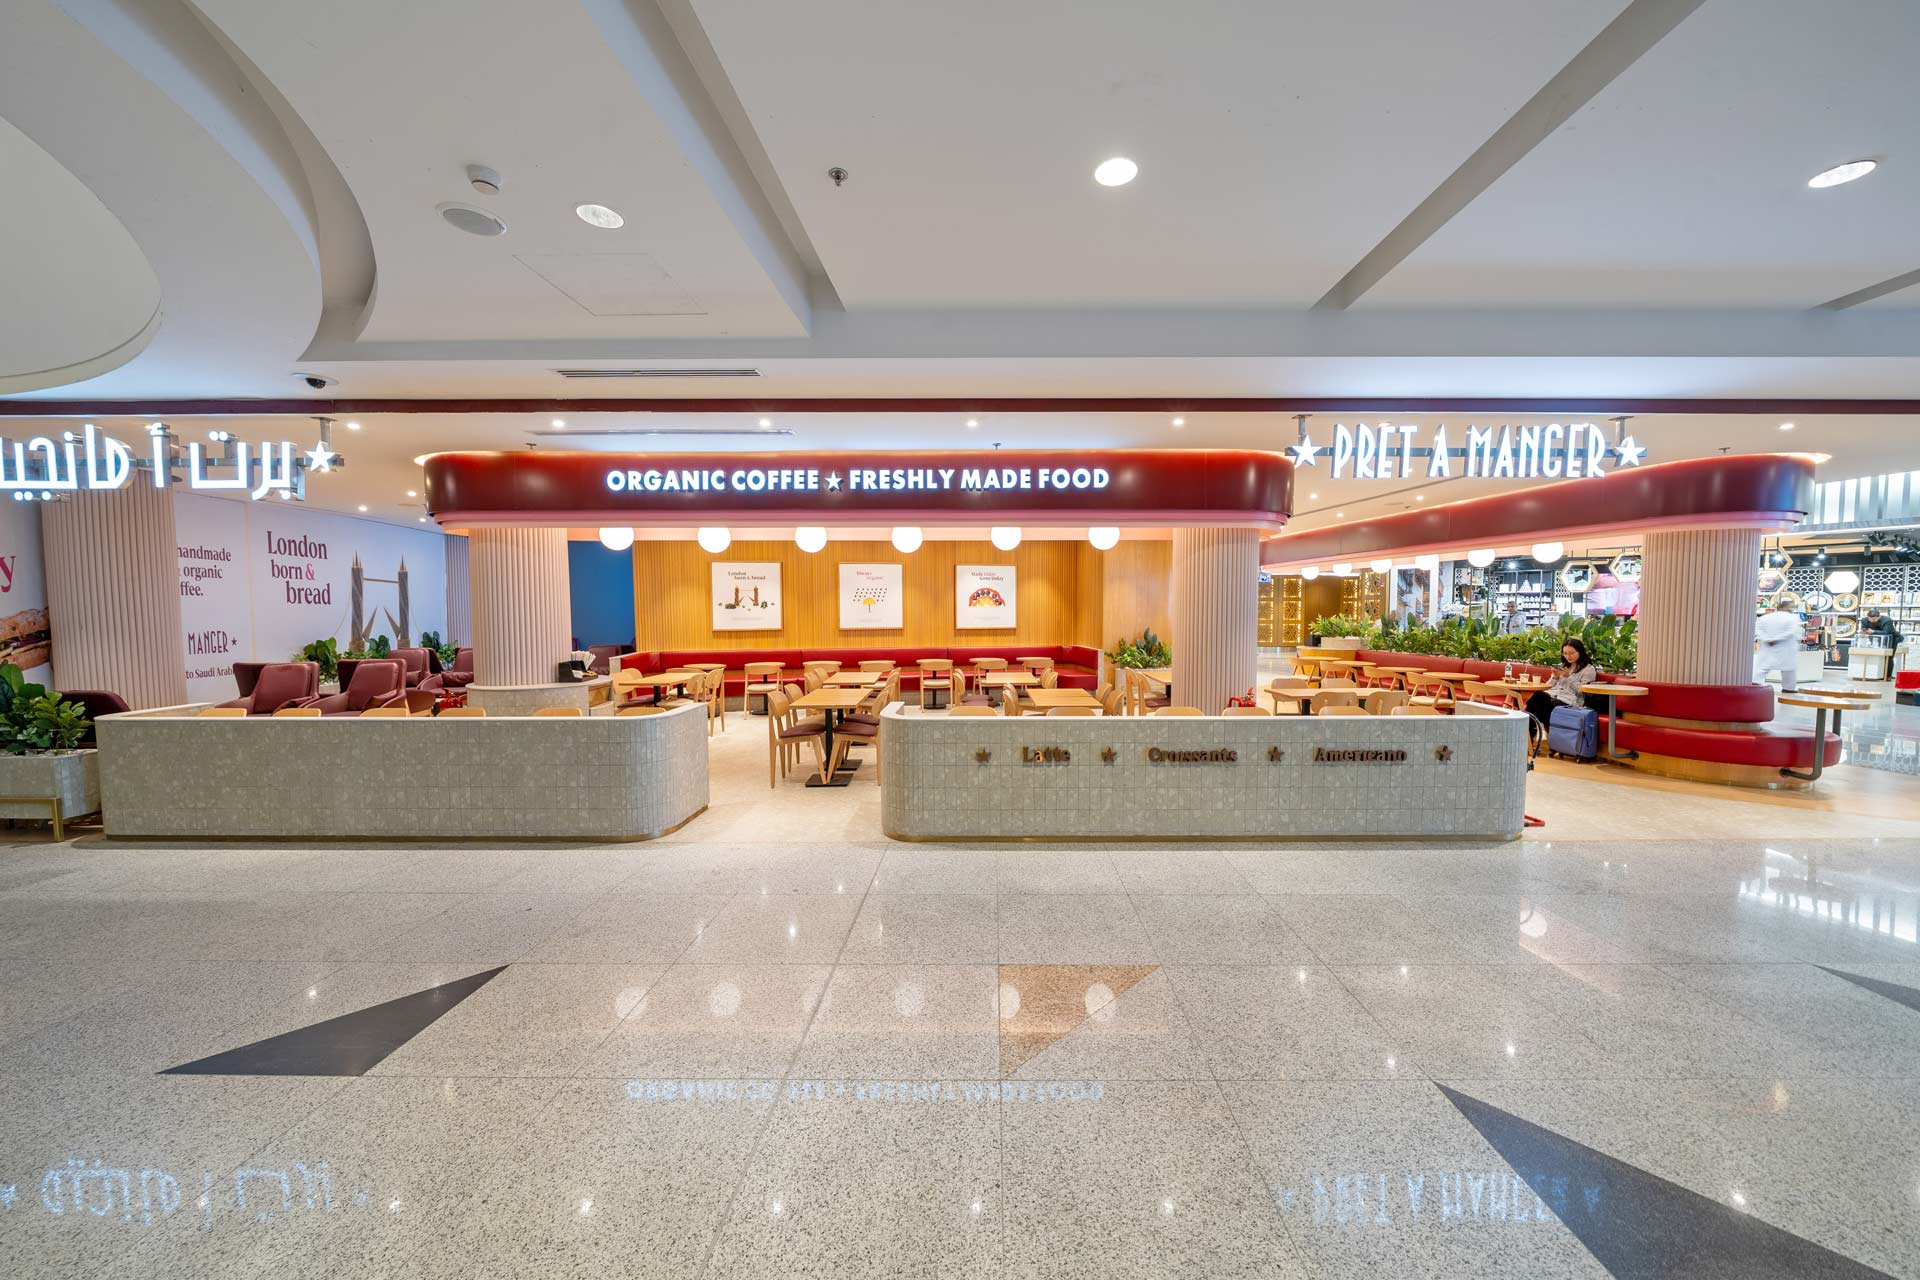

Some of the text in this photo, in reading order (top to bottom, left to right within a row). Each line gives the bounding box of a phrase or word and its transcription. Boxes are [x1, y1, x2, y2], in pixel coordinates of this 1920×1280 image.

[0, 423, 131, 501] مانجي
[1332, 422, 1606, 479] PRET A MANGER
[606, 468, 1109, 491] ORGANIC COFFEE FRESHLY MADE FOOD
[266, 530, 329, 560] London
[183, 564, 223, 582] organic
[271, 559, 316, 581] born &
[180, 581, 204, 596] ffee.
[285, 580, 332, 605] bread
[188, 630, 229, 655] MANGER
[185, 665, 233, 680] to Saudi Arab
[1022, 747, 1408, 763] Latte Croissants Americano
